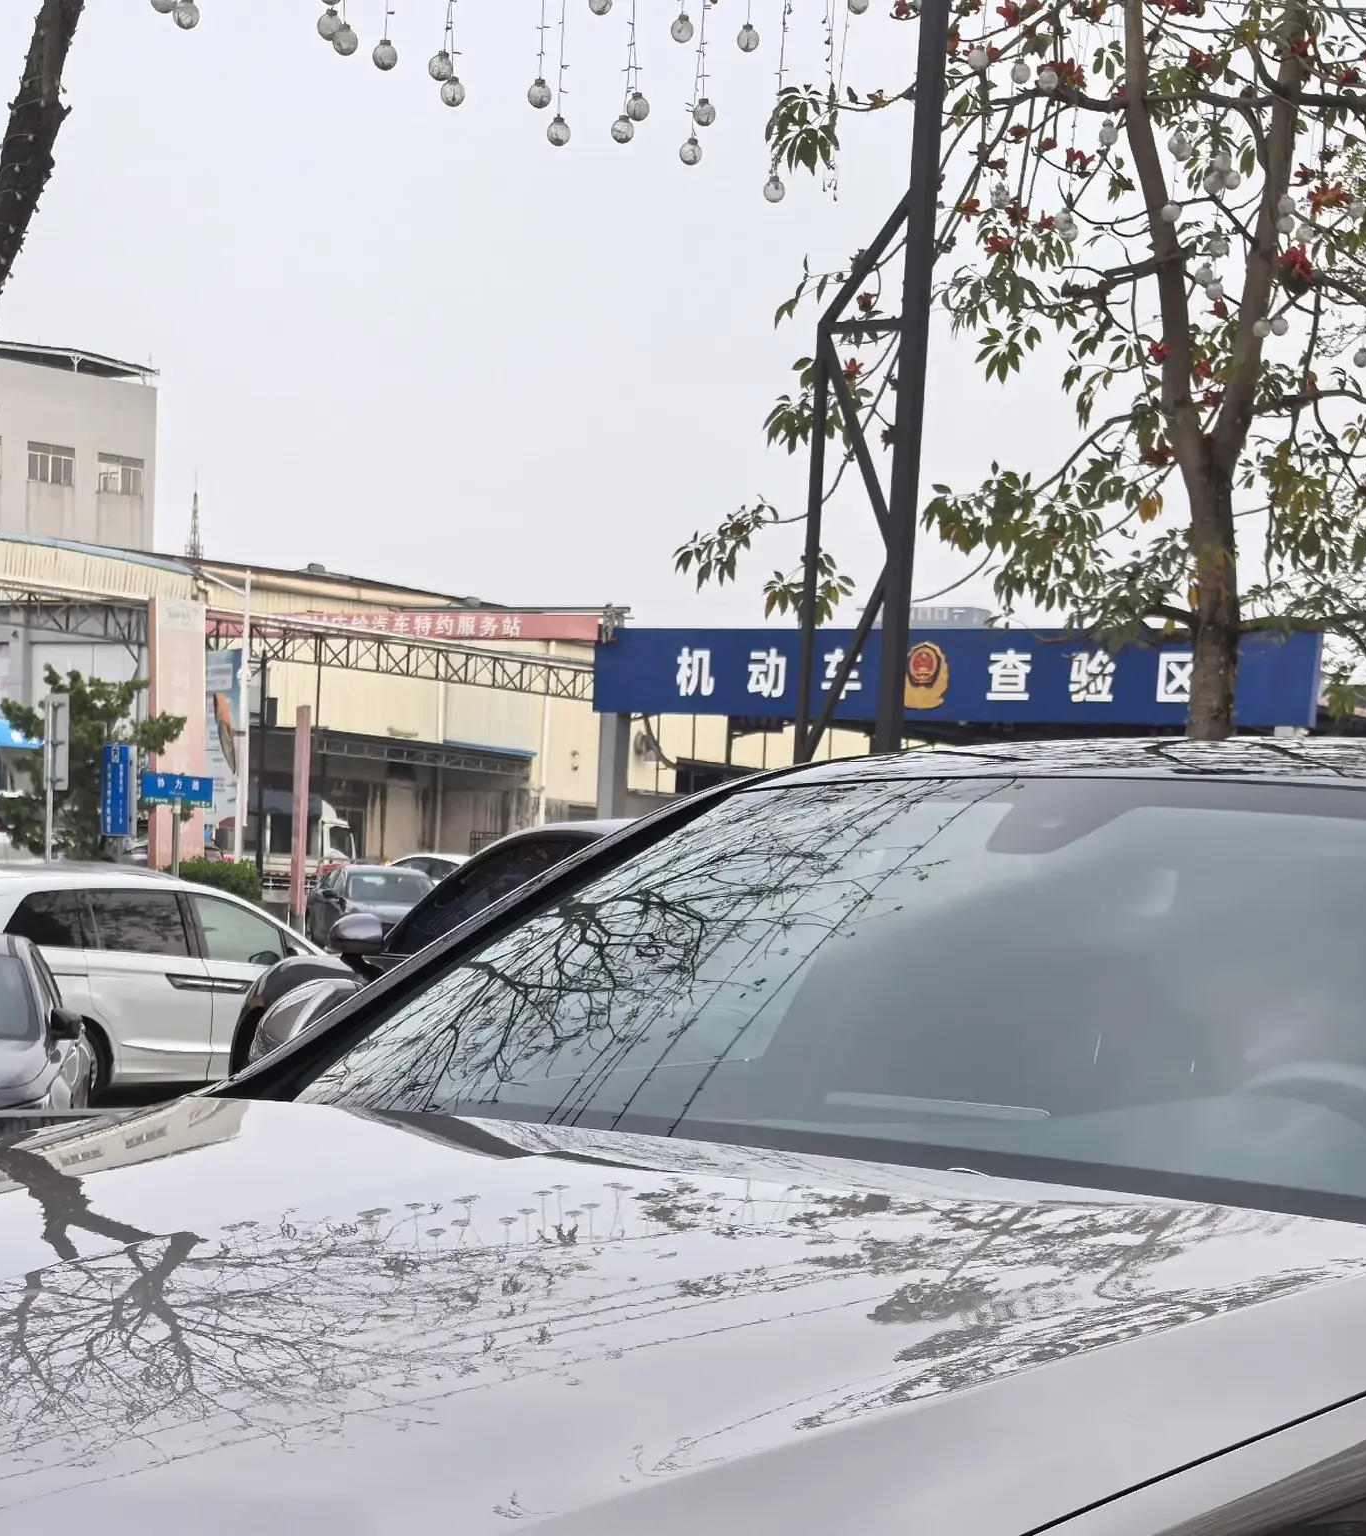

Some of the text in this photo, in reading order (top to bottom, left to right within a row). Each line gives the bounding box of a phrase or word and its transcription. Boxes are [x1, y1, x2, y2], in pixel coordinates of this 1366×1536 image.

[676, 647, 1195, 703] 机动车 查验区
